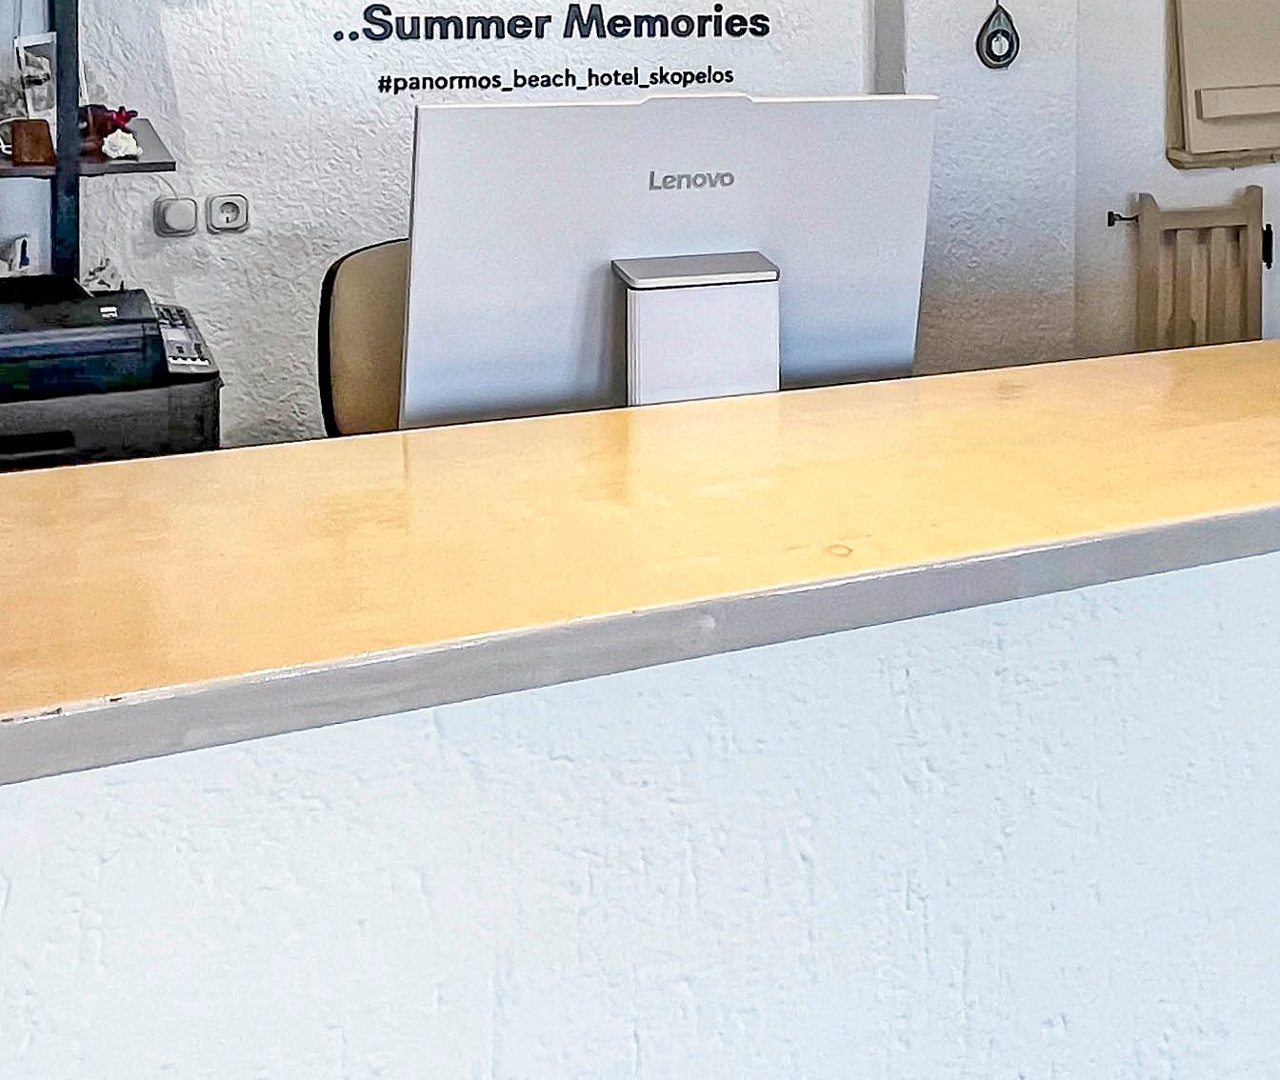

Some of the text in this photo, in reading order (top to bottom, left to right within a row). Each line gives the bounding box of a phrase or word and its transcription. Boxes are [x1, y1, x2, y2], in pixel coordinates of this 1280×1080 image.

[333, 3, 771, 42] ..Summer Memories
[377, 65, 735, 94] #panormos_beach_hotel_skopelos
[648, 170, 735, 191] Lenovo
